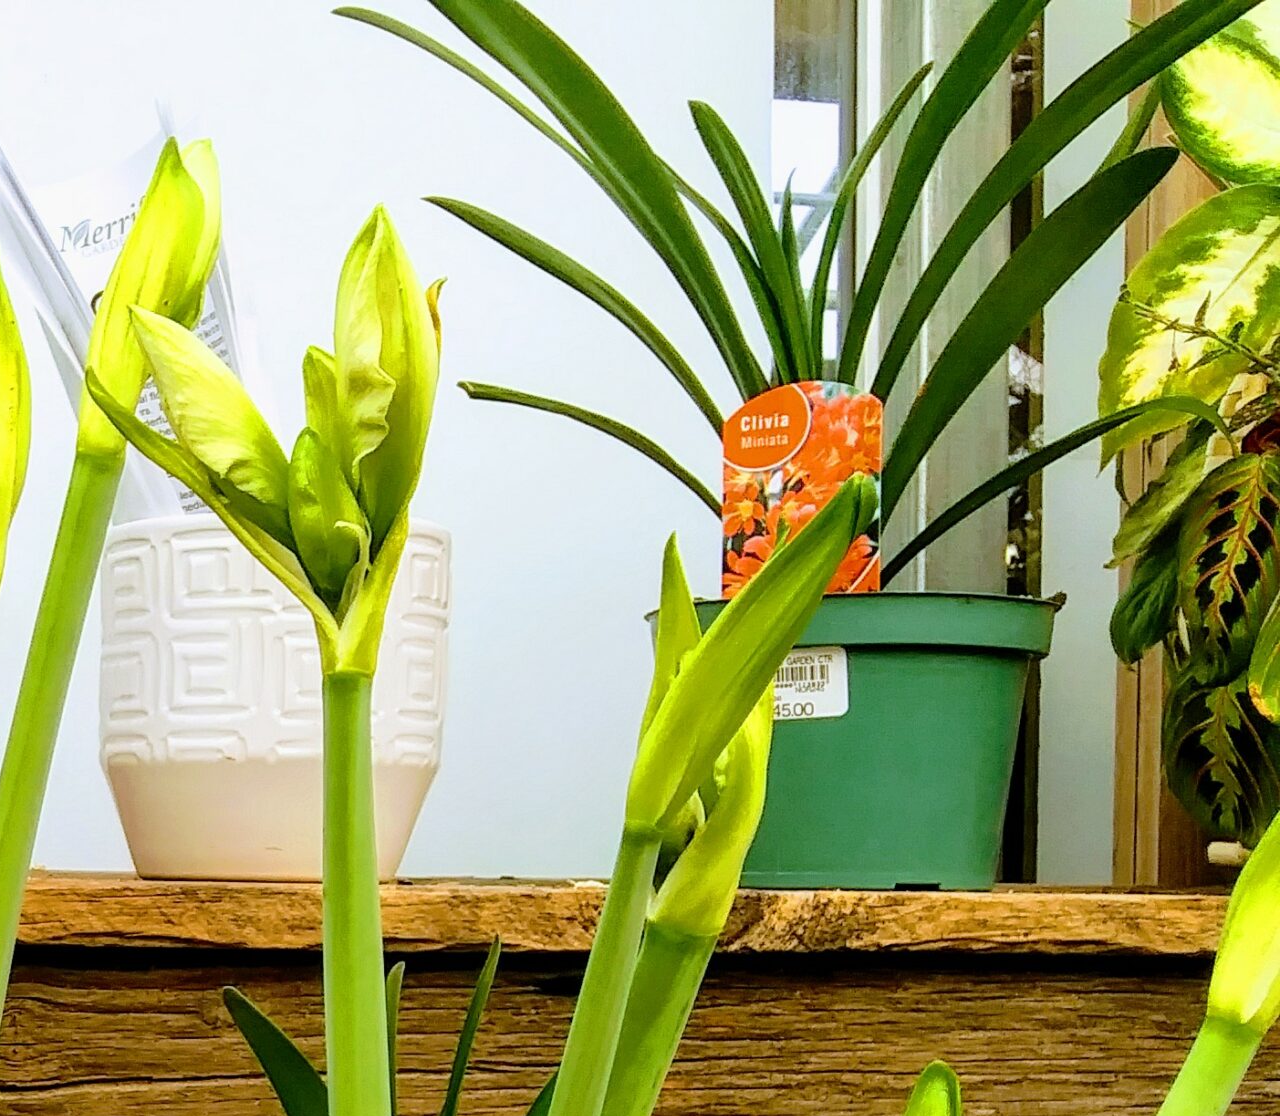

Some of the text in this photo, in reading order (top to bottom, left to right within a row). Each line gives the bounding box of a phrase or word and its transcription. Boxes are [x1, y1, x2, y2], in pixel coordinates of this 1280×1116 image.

[58, 198, 139, 253] Merri
[740, 413, 790, 432] Clivia
[741, 434, 789, 449] Miniata
[786, 654, 833, 665] GARDEN CTR
[773, 702, 814, 717] 45.00
